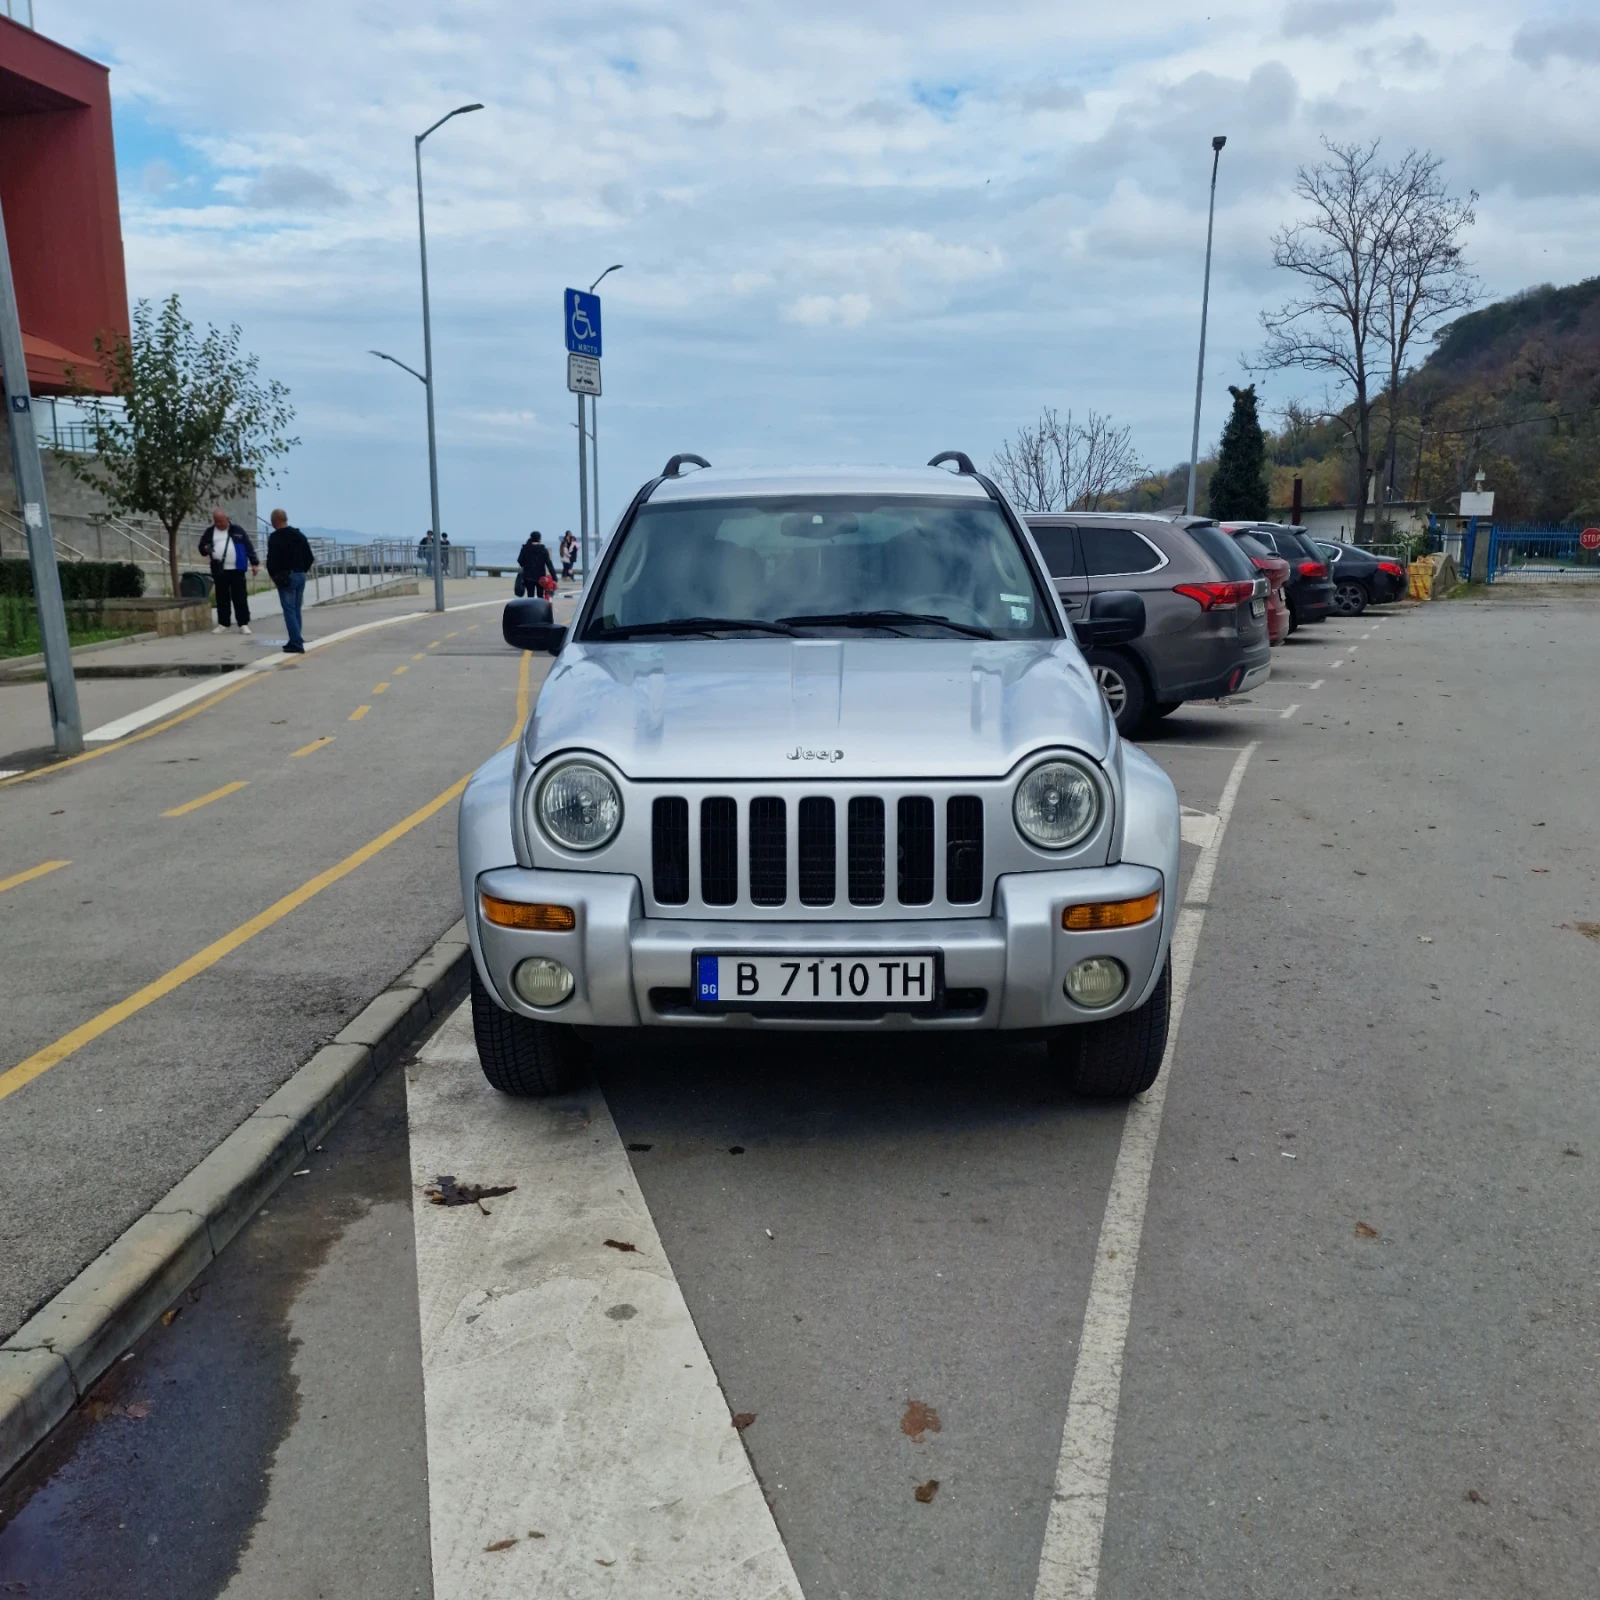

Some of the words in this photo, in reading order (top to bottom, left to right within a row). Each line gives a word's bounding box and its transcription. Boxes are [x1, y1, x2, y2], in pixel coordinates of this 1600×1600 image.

[1582, 534, 1600, 543] STOP
[786, 746, 844, 763] Jeep
[737, 962, 759, 996] B
[780, 962, 869, 996] 7110
[879, 962, 925, 996] TH
[701, 984, 717, 995] BG
